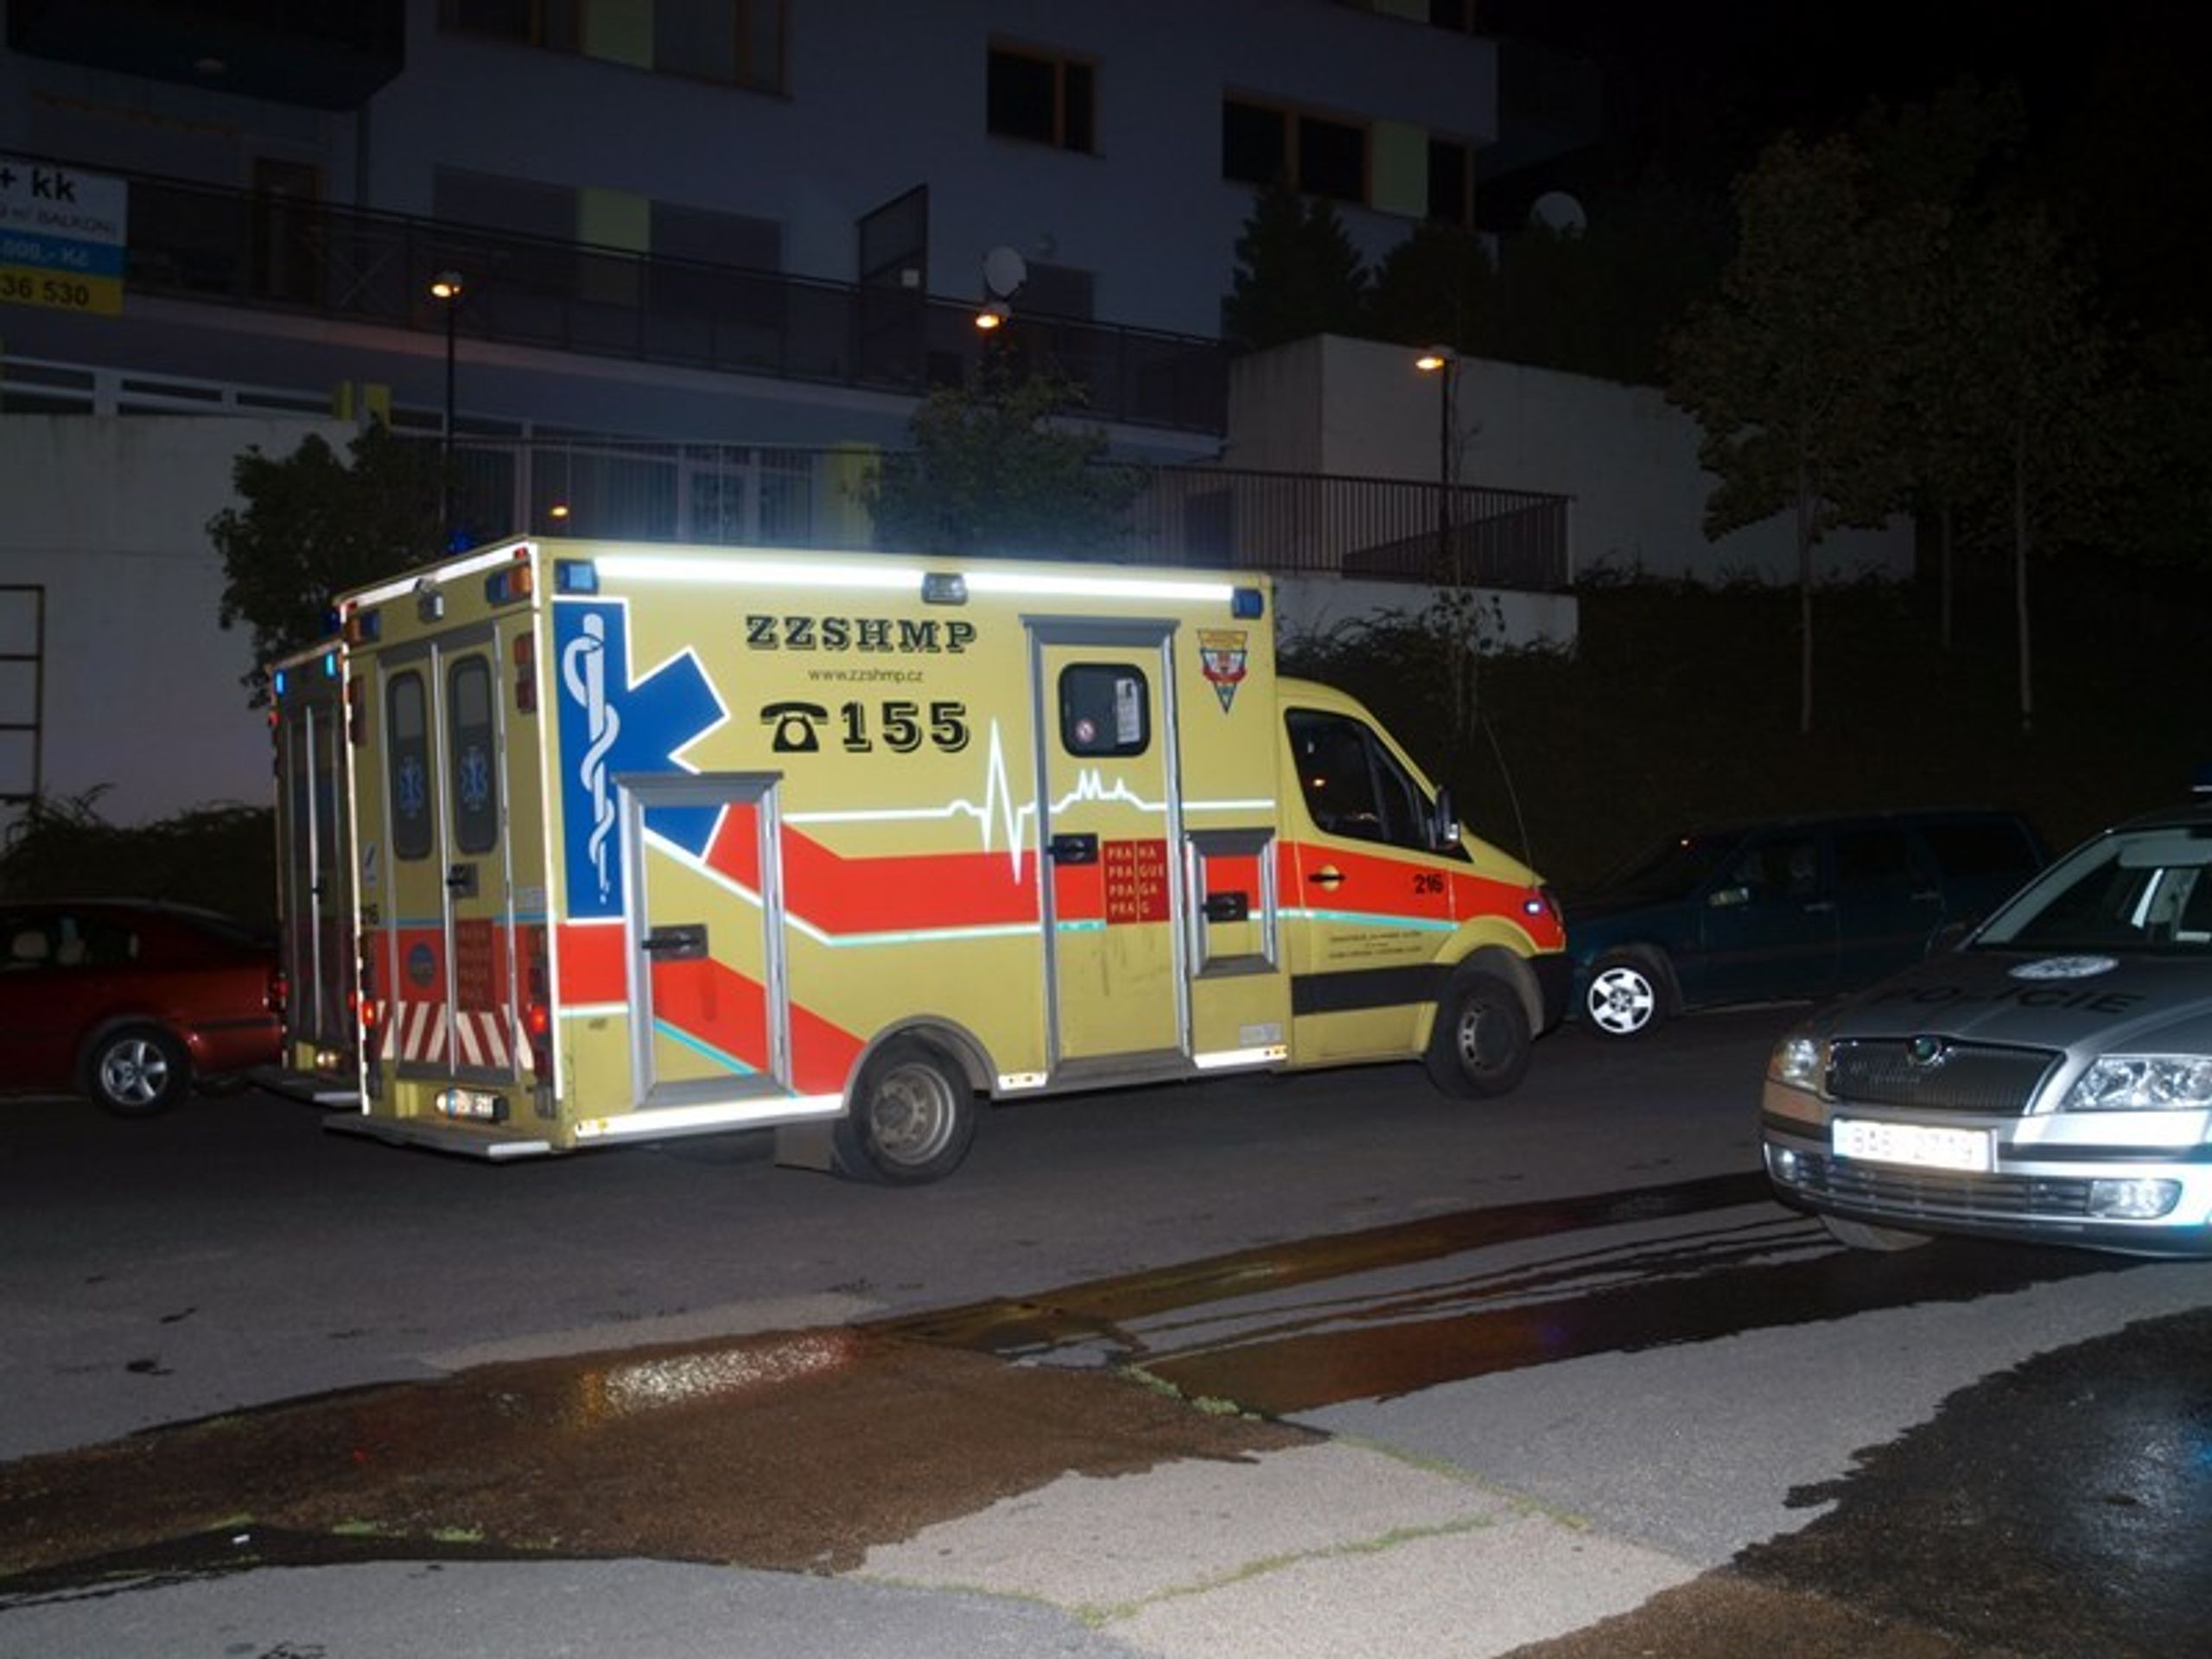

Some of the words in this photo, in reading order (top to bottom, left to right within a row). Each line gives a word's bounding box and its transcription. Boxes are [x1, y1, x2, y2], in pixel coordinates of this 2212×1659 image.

[32, 167, 76, 202] kk
[42, 279, 90, 306] 530
[746, 615, 977, 653] ZZSHMP
[808, 668, 925, 683] www.zzshmp.cz
[840, 701, 970, 753] 155
[1870, 986, 2145, 1014] POLICIE
